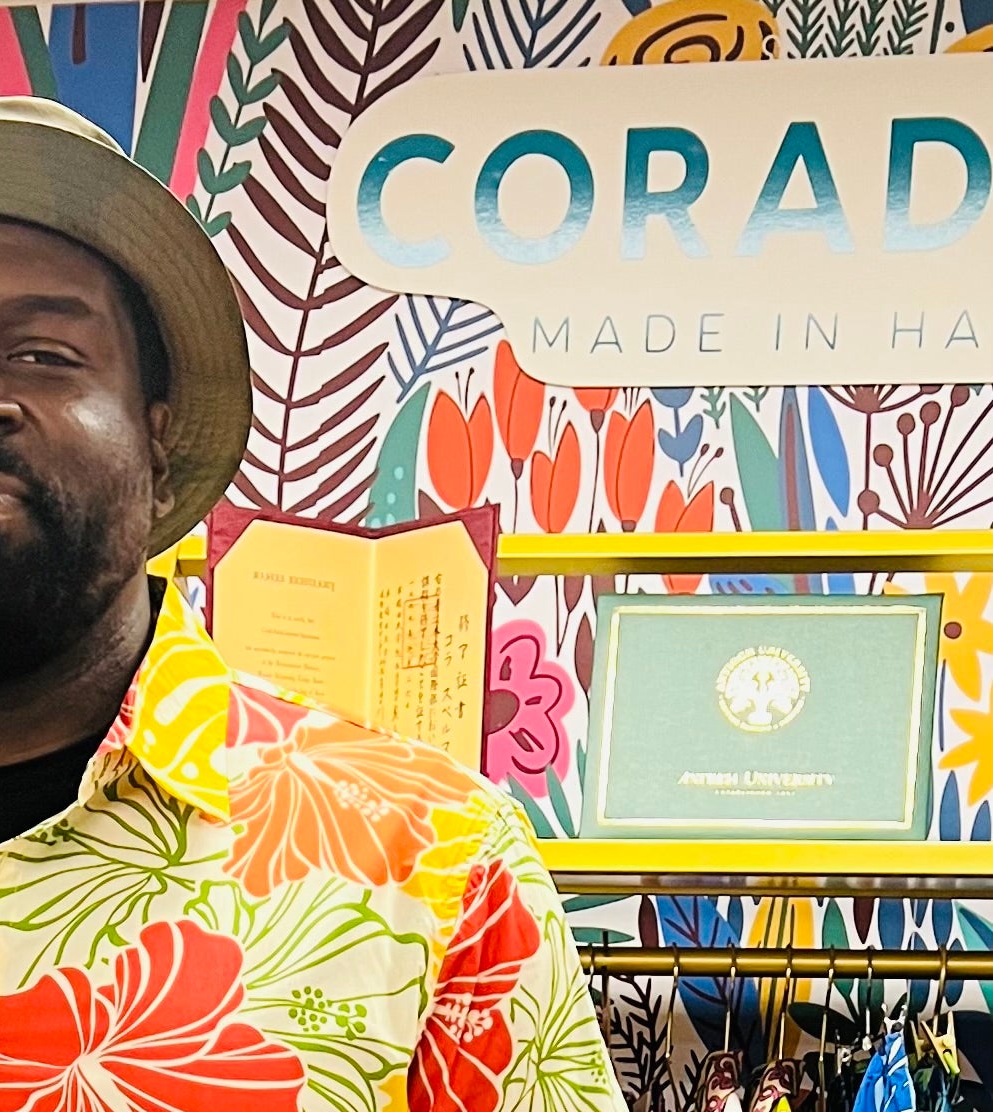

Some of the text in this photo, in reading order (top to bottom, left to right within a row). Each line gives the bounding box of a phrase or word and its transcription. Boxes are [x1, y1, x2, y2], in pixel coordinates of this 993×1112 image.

[356, 116, 992, 269] CORAD
[532, 309, 980, 354] MADE IN HA
